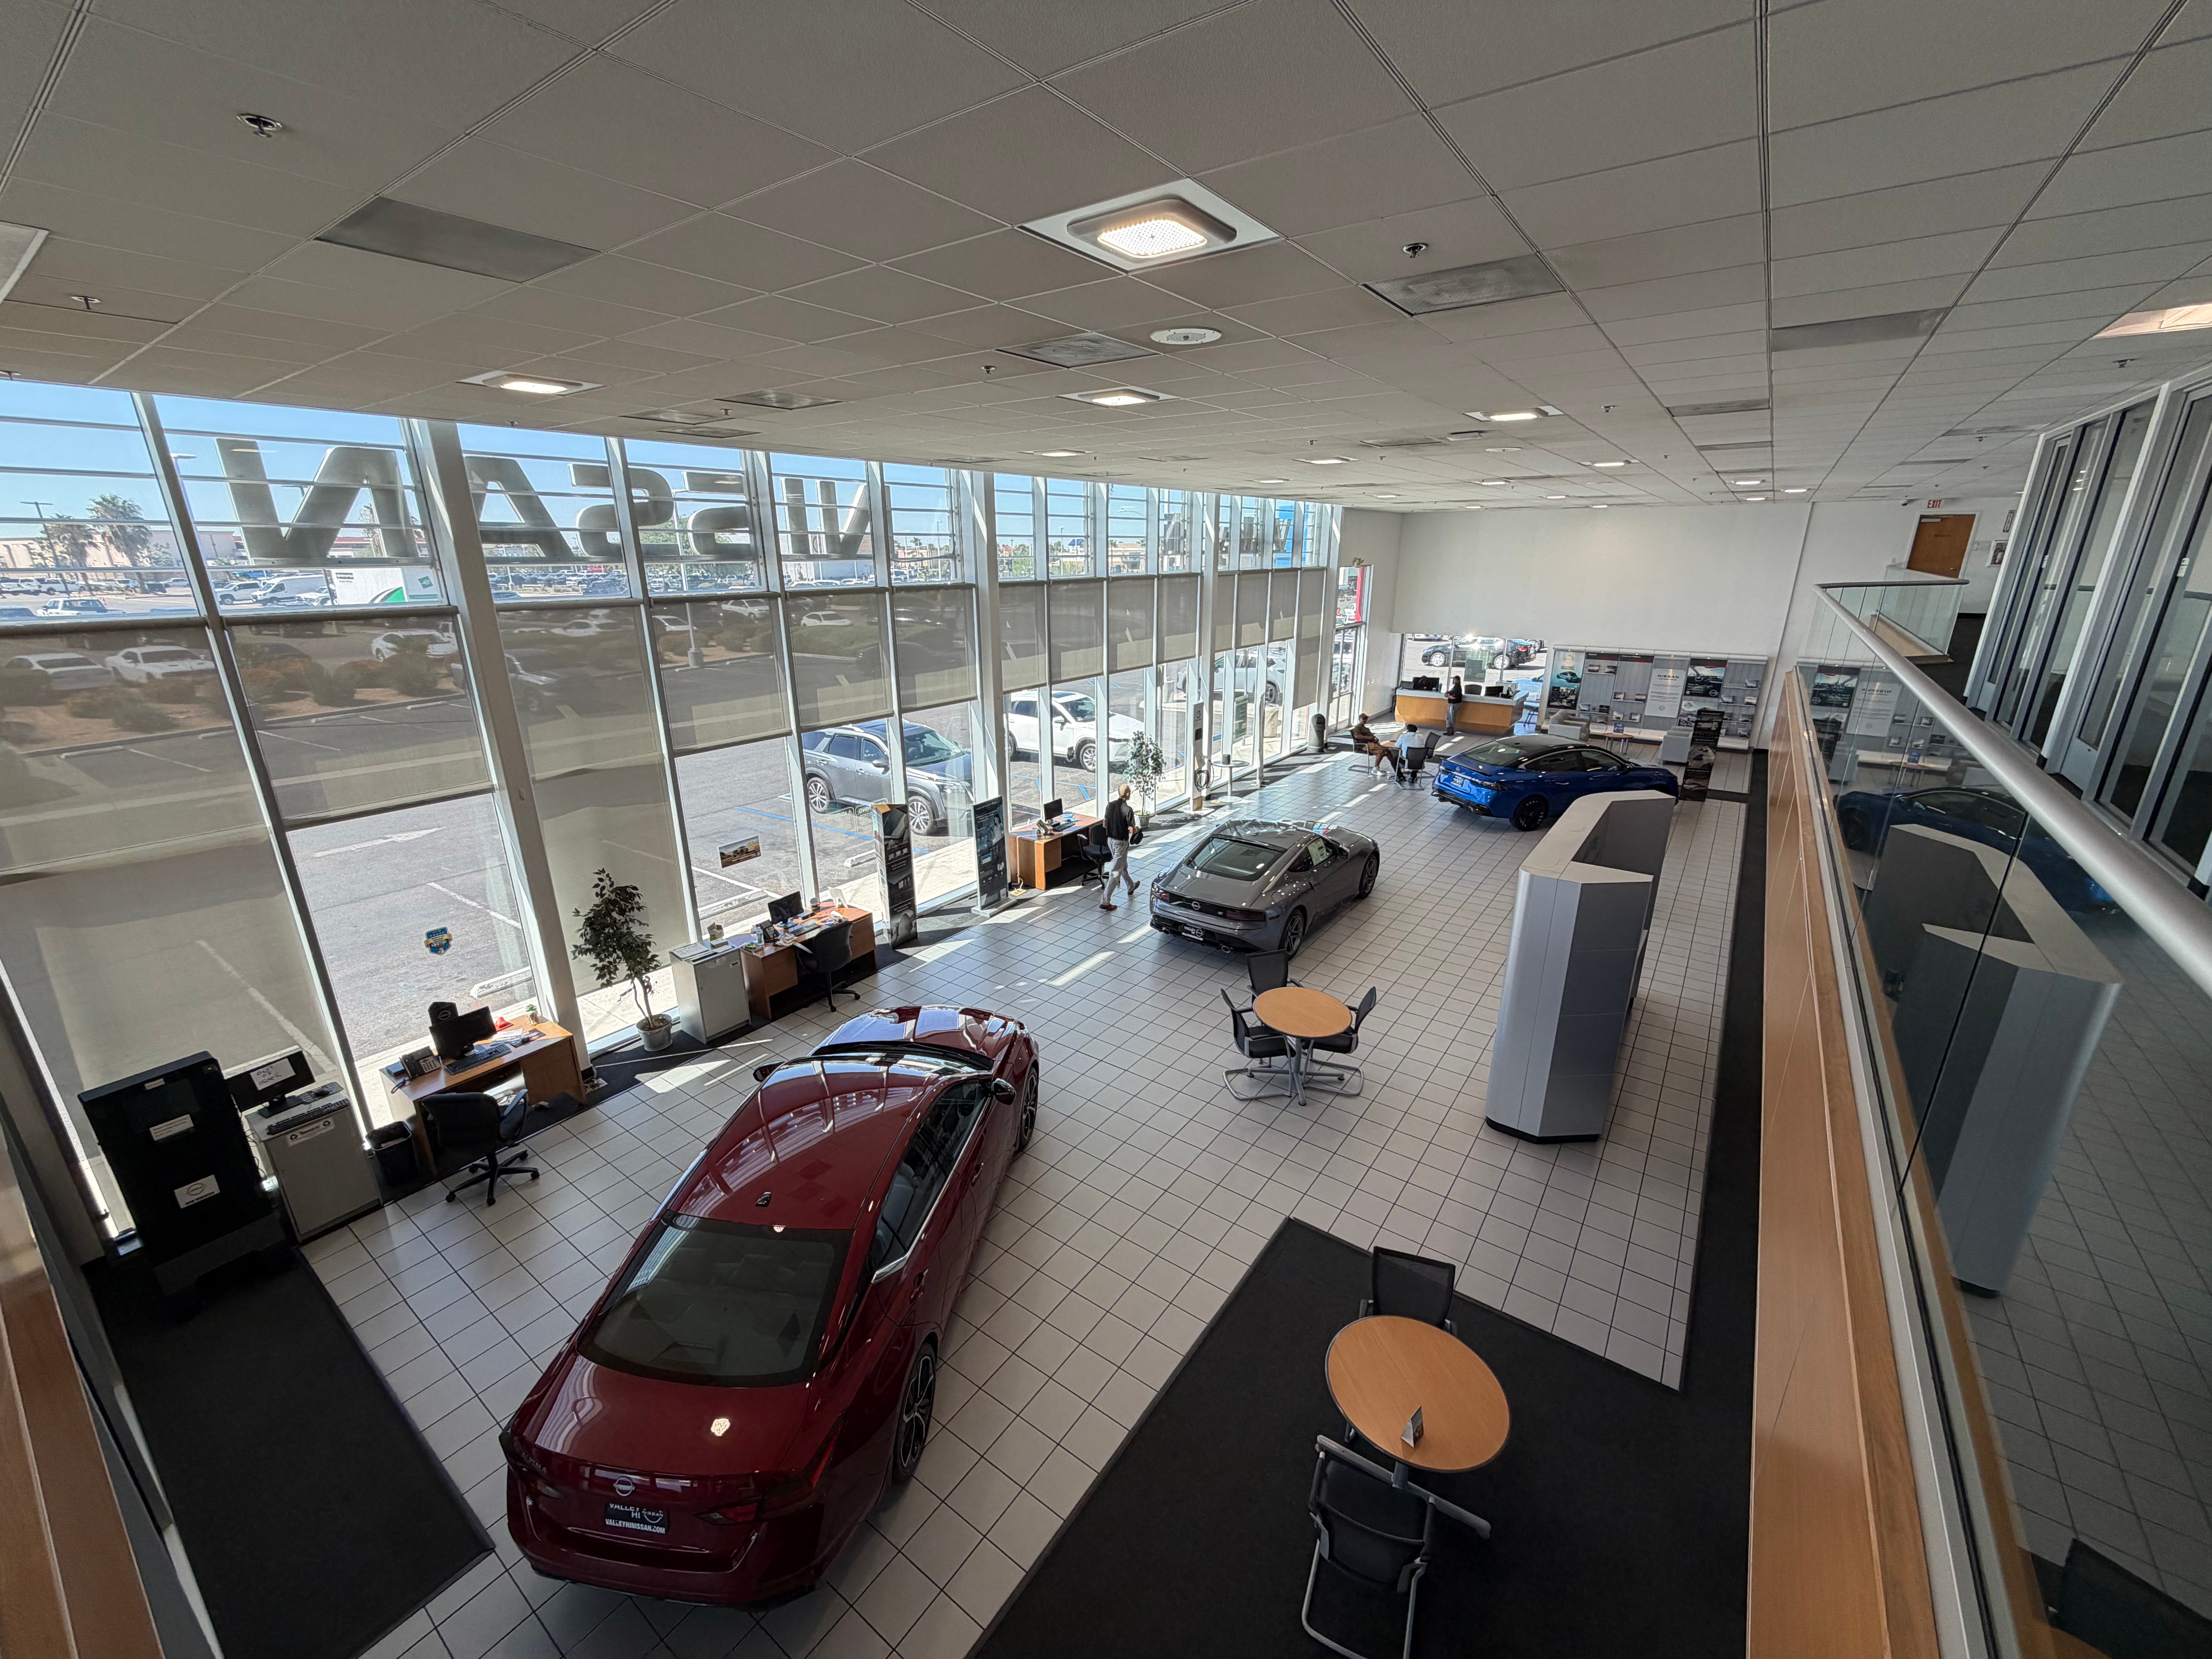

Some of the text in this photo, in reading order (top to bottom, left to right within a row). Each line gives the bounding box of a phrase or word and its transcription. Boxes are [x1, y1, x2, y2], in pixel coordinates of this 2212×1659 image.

[1927, 500, 1942, 508] EXIT
[609, 1503, 640, 1512] VALLEY
[605, 1518, 666, 1534] VALLEYHINISSAN.COM
